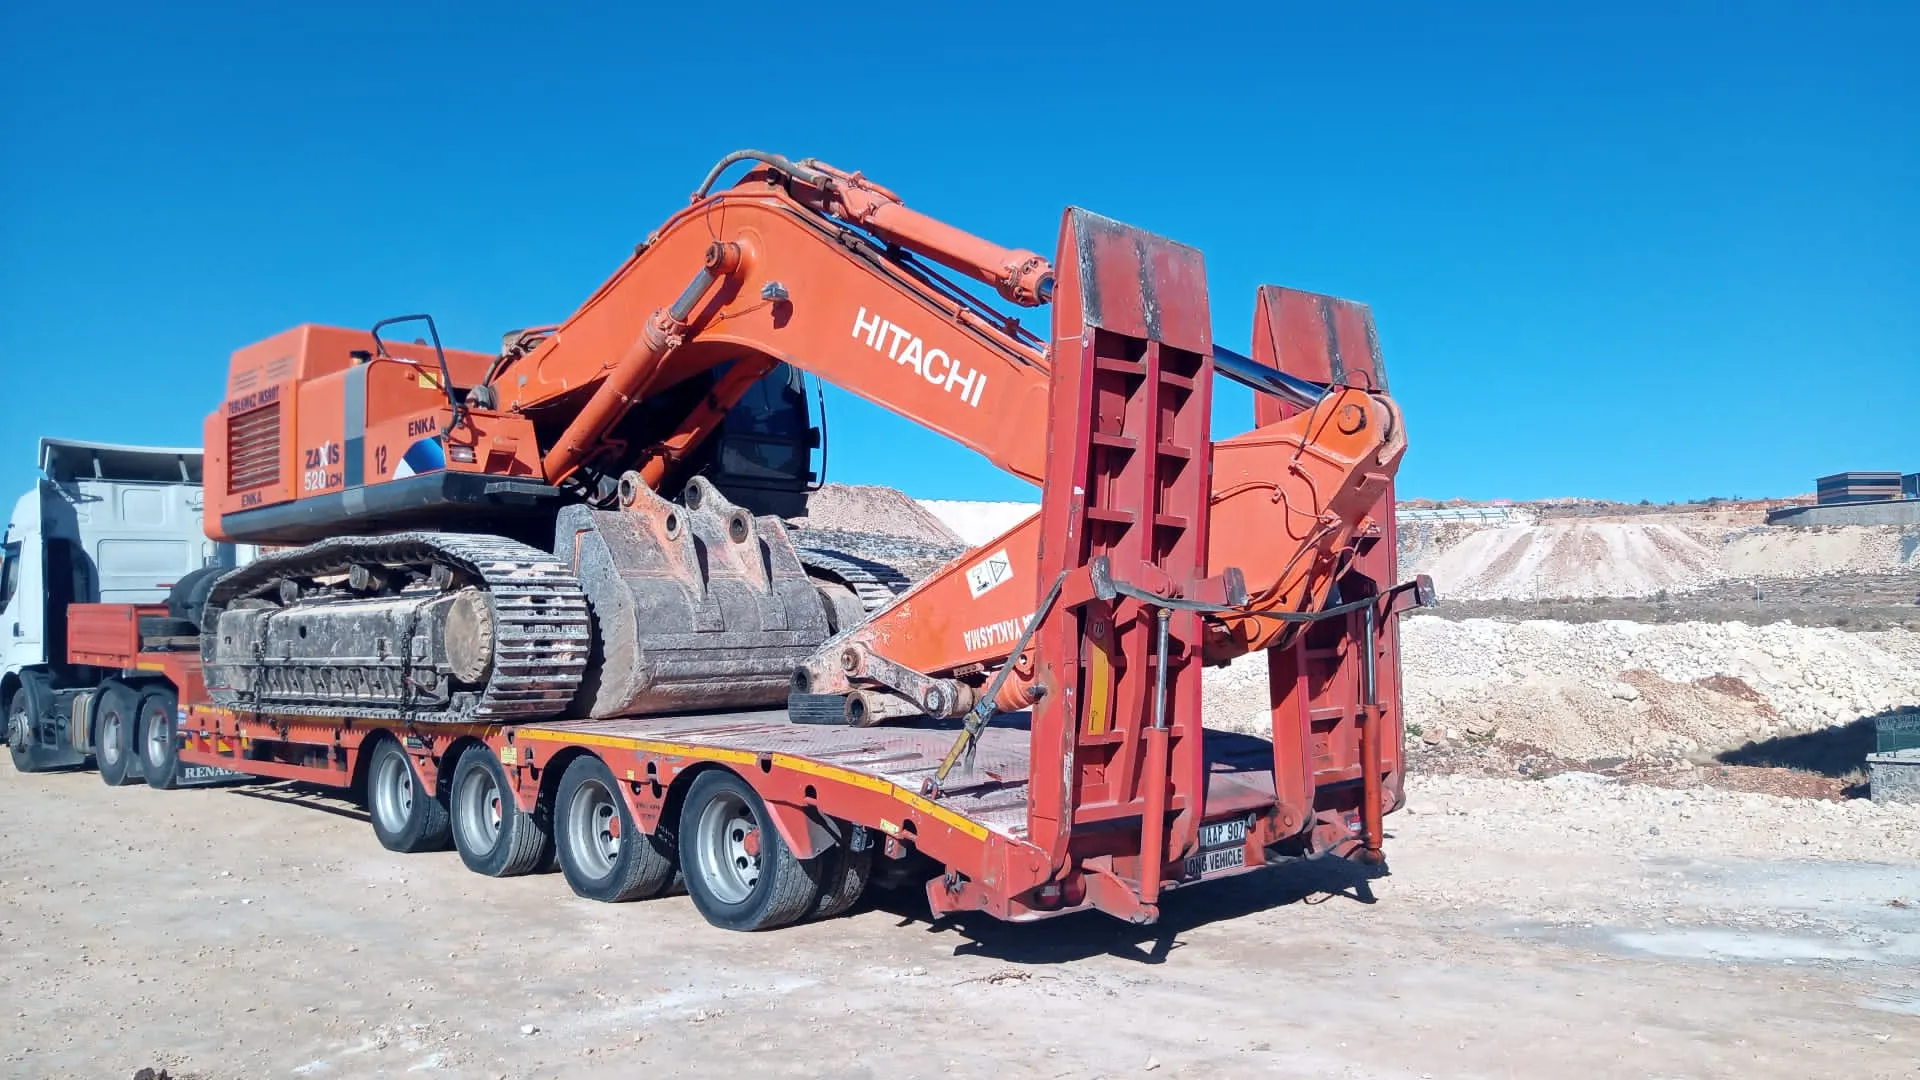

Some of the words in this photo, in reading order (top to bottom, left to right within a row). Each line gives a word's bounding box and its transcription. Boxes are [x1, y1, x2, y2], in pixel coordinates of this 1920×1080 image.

[852, 306, 987, 408] HITACHI
[408, 416, 436, 437] ENKA
[305, 440, 340, 469] ZAXIS
[375, 444, 387, 475] 12
[963, 618, 1022, 653] YAKLASMA
[1228, 822, 1244, 841] 907
[1209, 849, 1242, 869] VEHICLE
